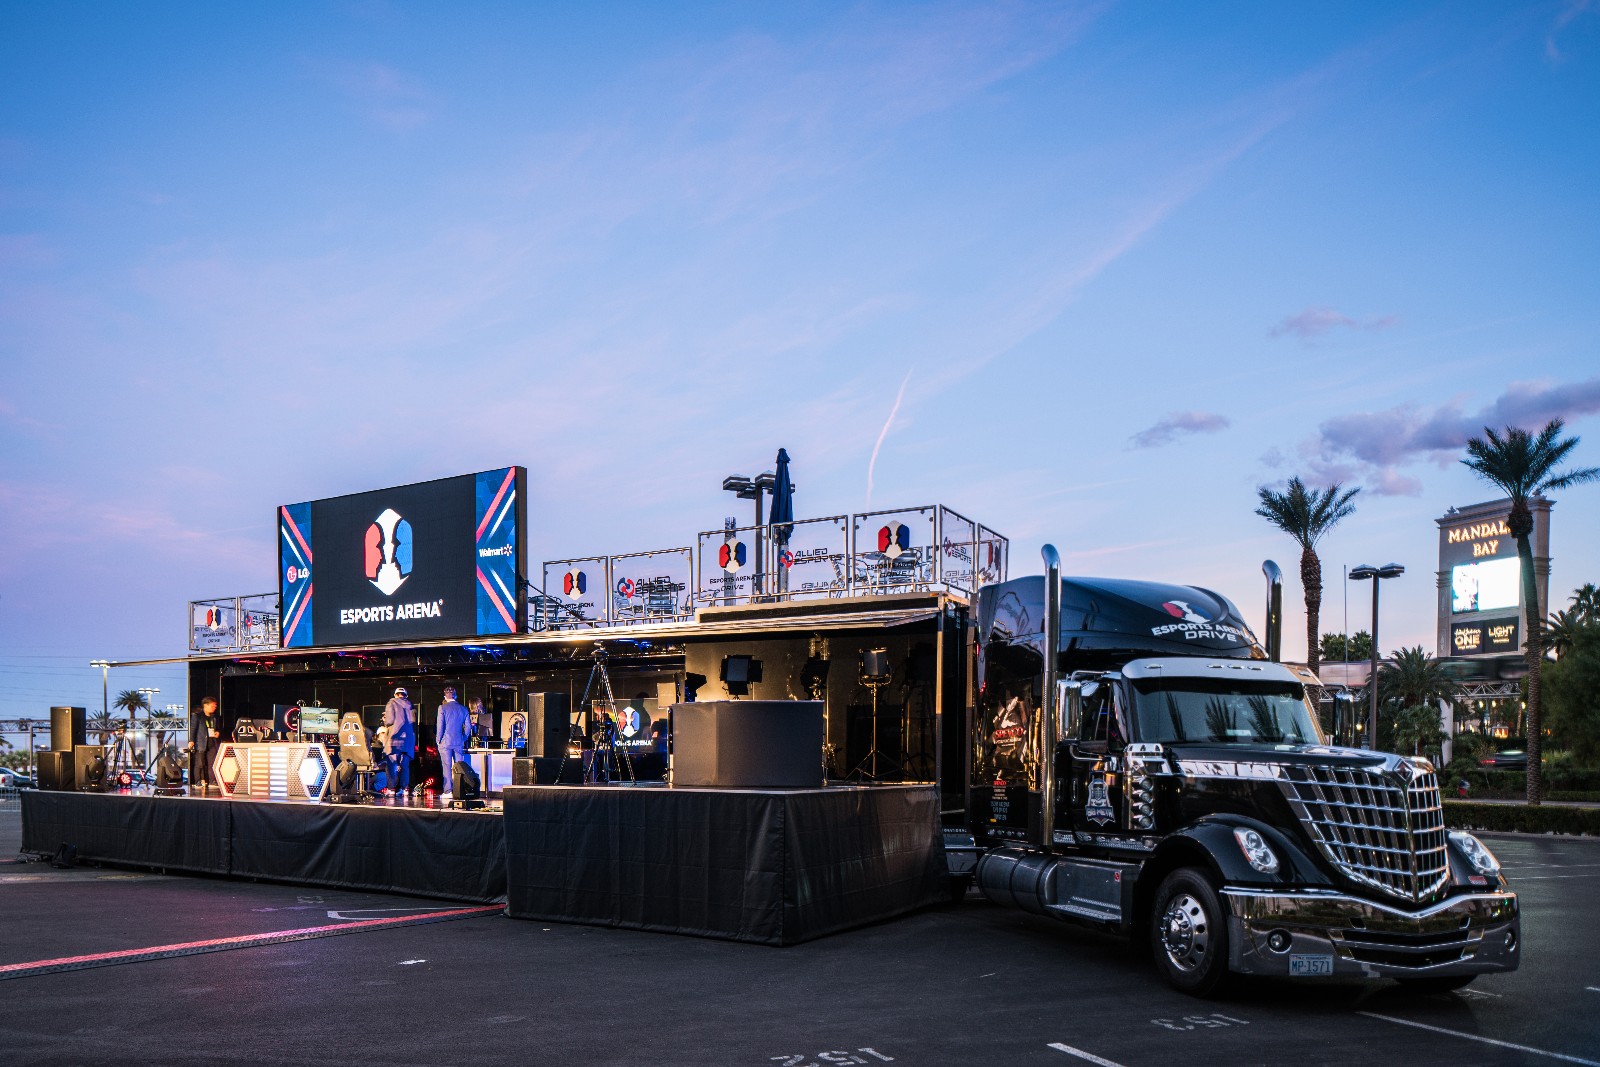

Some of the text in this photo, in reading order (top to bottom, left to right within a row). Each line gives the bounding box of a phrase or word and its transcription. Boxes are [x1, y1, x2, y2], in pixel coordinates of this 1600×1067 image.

[1448, 520, 1511, 544] MANDAL
[479, 547, 503, 557] Walmart
[794, 548, 828, 557] ALLIED
[1472, 539, 1499, 557] BAY
[340, 605, 394, 625] ESPORTS
[1151, 623, 1213, 636] ESPORTS
[1488, 625, 1515, 637] LIGHT
[1185, 630, 1237, 642] DRIVE
[1455, 635, 1480, 646] ONE
